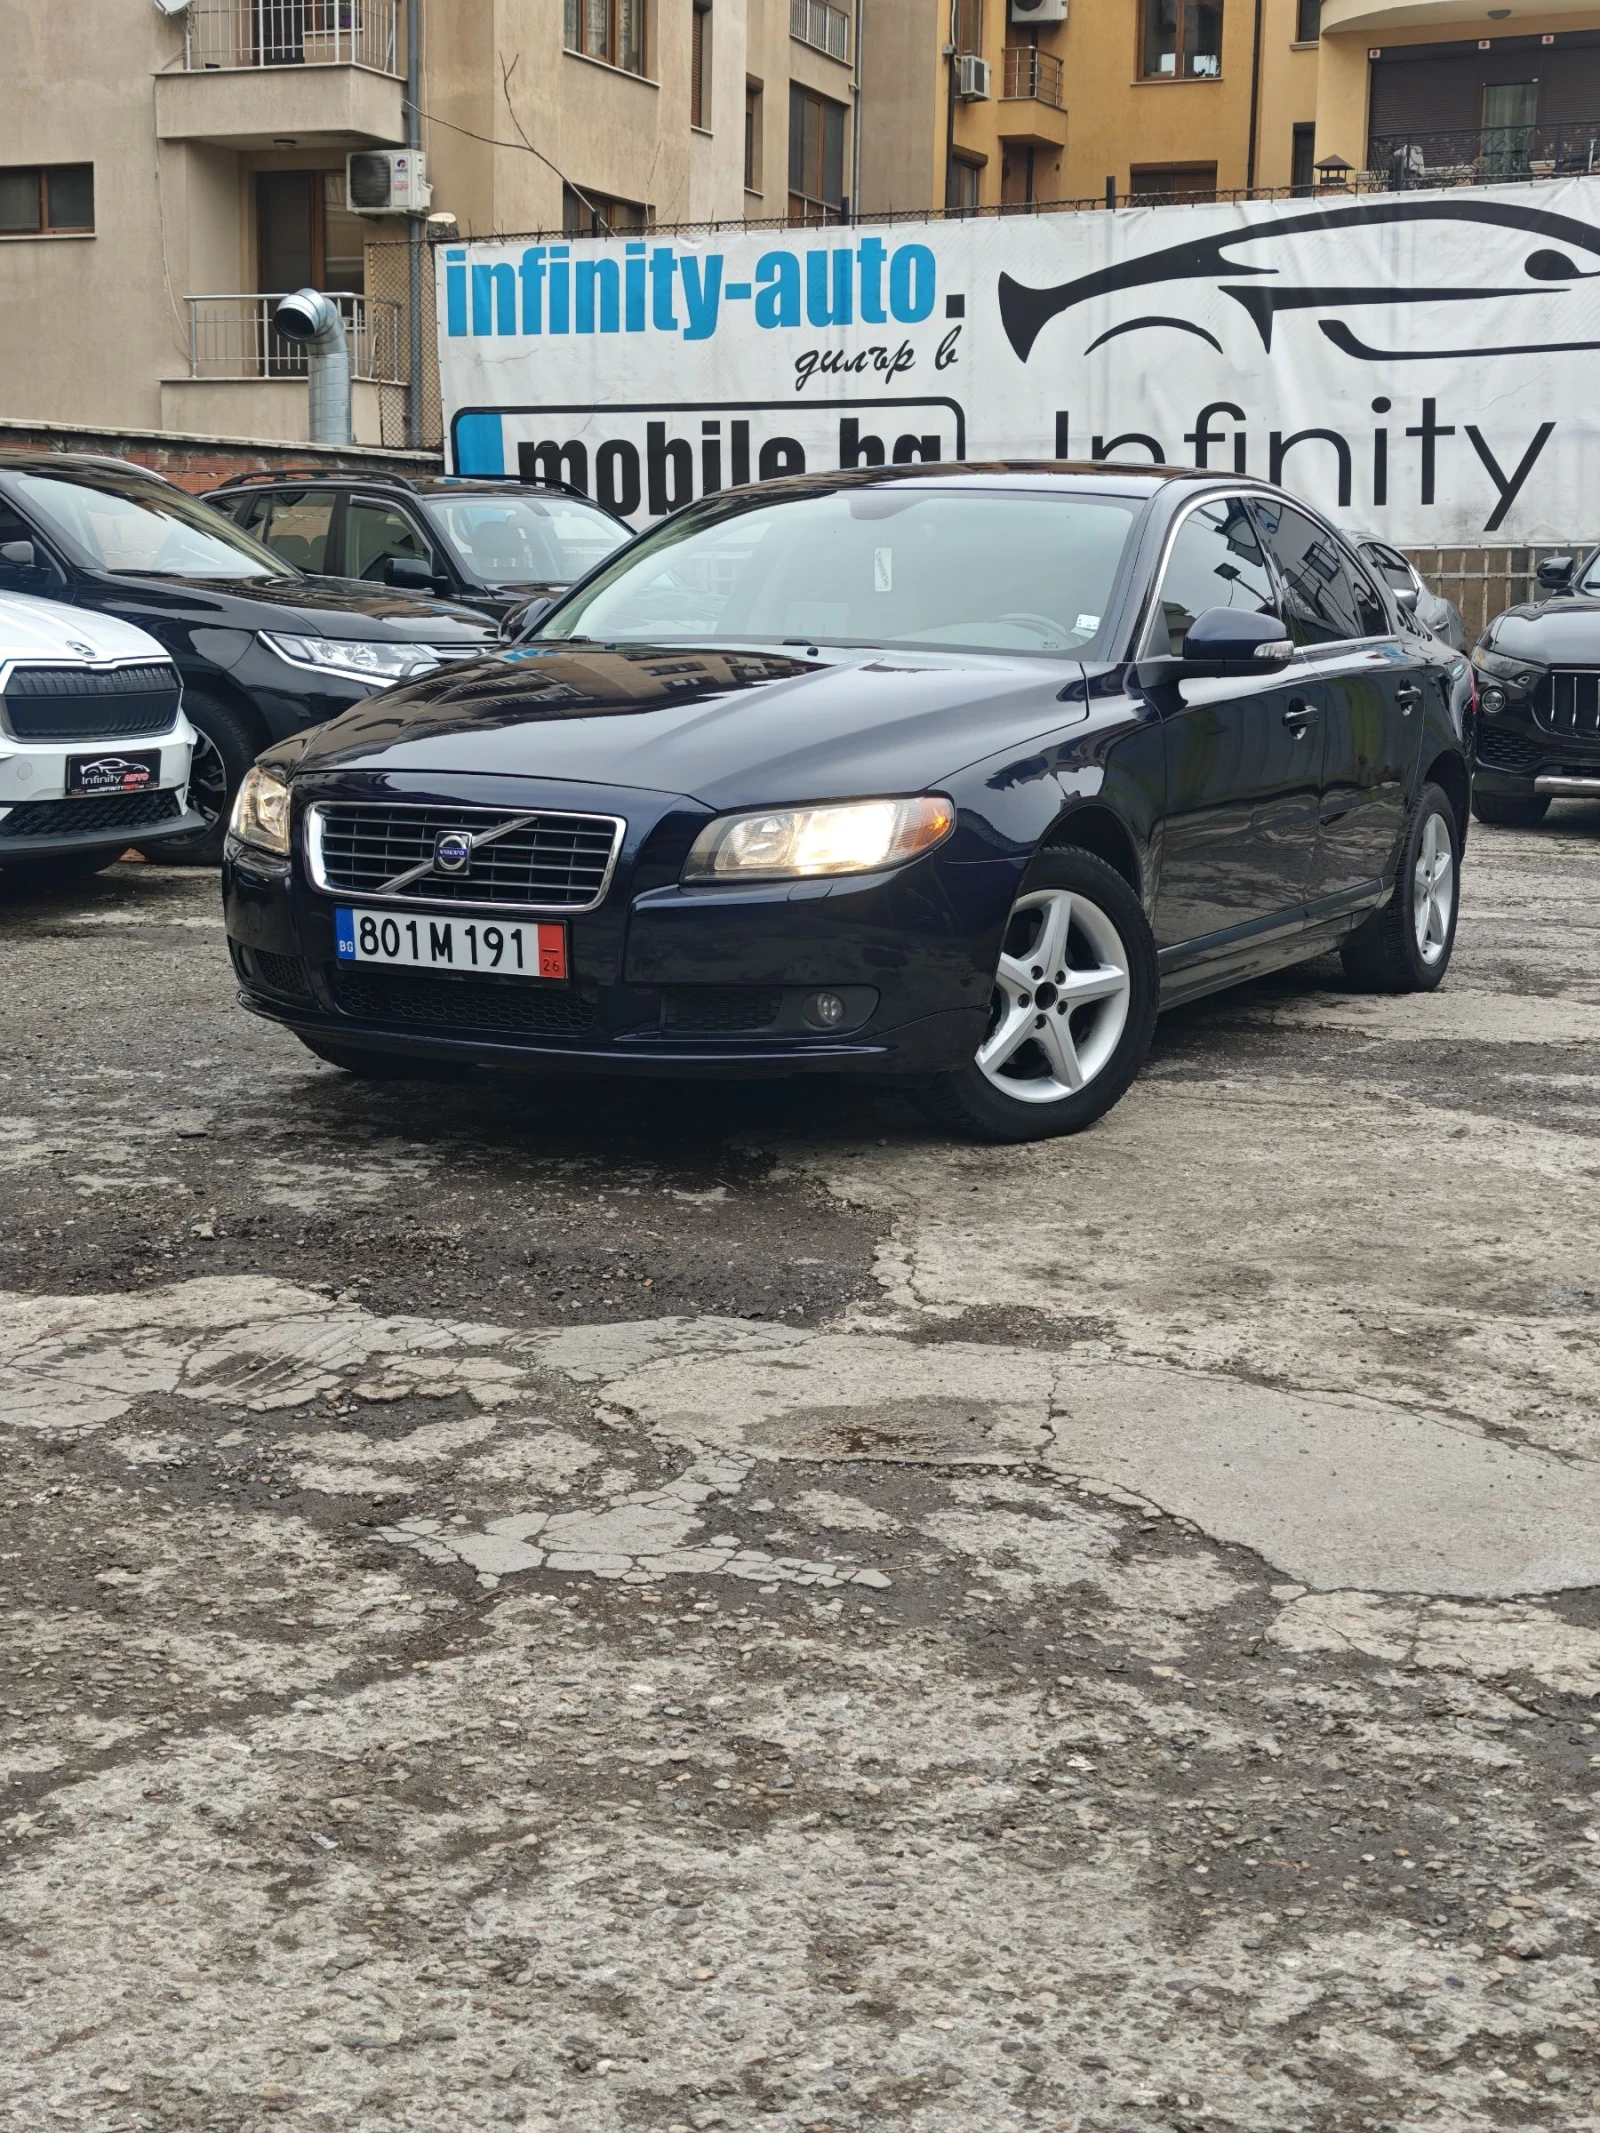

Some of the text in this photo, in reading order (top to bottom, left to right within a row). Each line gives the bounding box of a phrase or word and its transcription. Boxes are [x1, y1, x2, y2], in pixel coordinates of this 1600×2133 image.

[794, 339, 916, 392] дилър
[82, 774, 121, 785] Infinity
[339, 940, 354, 952] BG
[543, 958, 560, 972] 26
